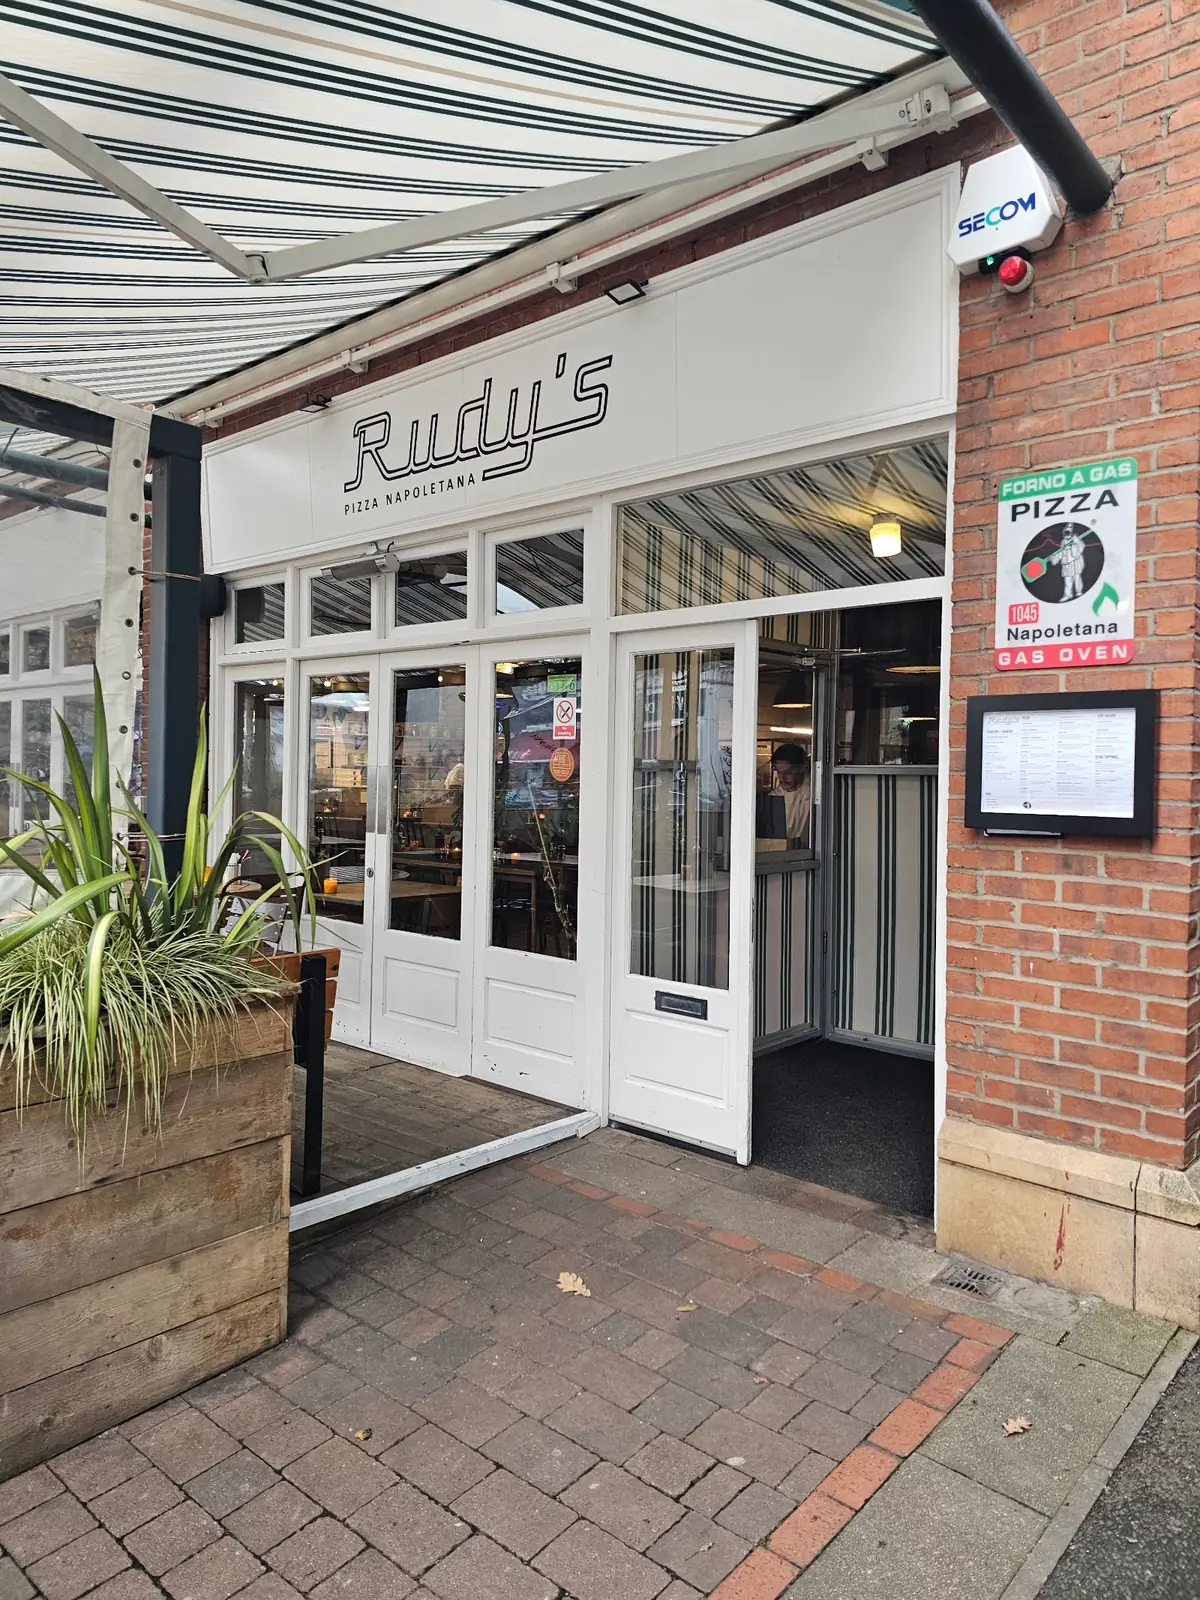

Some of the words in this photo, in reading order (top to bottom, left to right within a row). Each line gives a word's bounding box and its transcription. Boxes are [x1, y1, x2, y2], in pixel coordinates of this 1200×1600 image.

[958, 192, 1036, 238] SECOM
[343, 352, 613, 493] Rudy's
[344, 497, 379, 516] PIZZA
[385, 472, 476, 506] NAPOLETANA
[1002, 473, 1066, 497] FORNO
[1070, 469, 1085, 485] A
[1090, 462, 1132, 482] GAS
[1011, 489, 1120, 522] PIZZA
[1010, 604, 1038, 623] 1045
[1007, 621, 1118, 643] Napoletana
[998, 650, 1045, 665] GAS
[1059, 644, 1128, 662] OVEN
